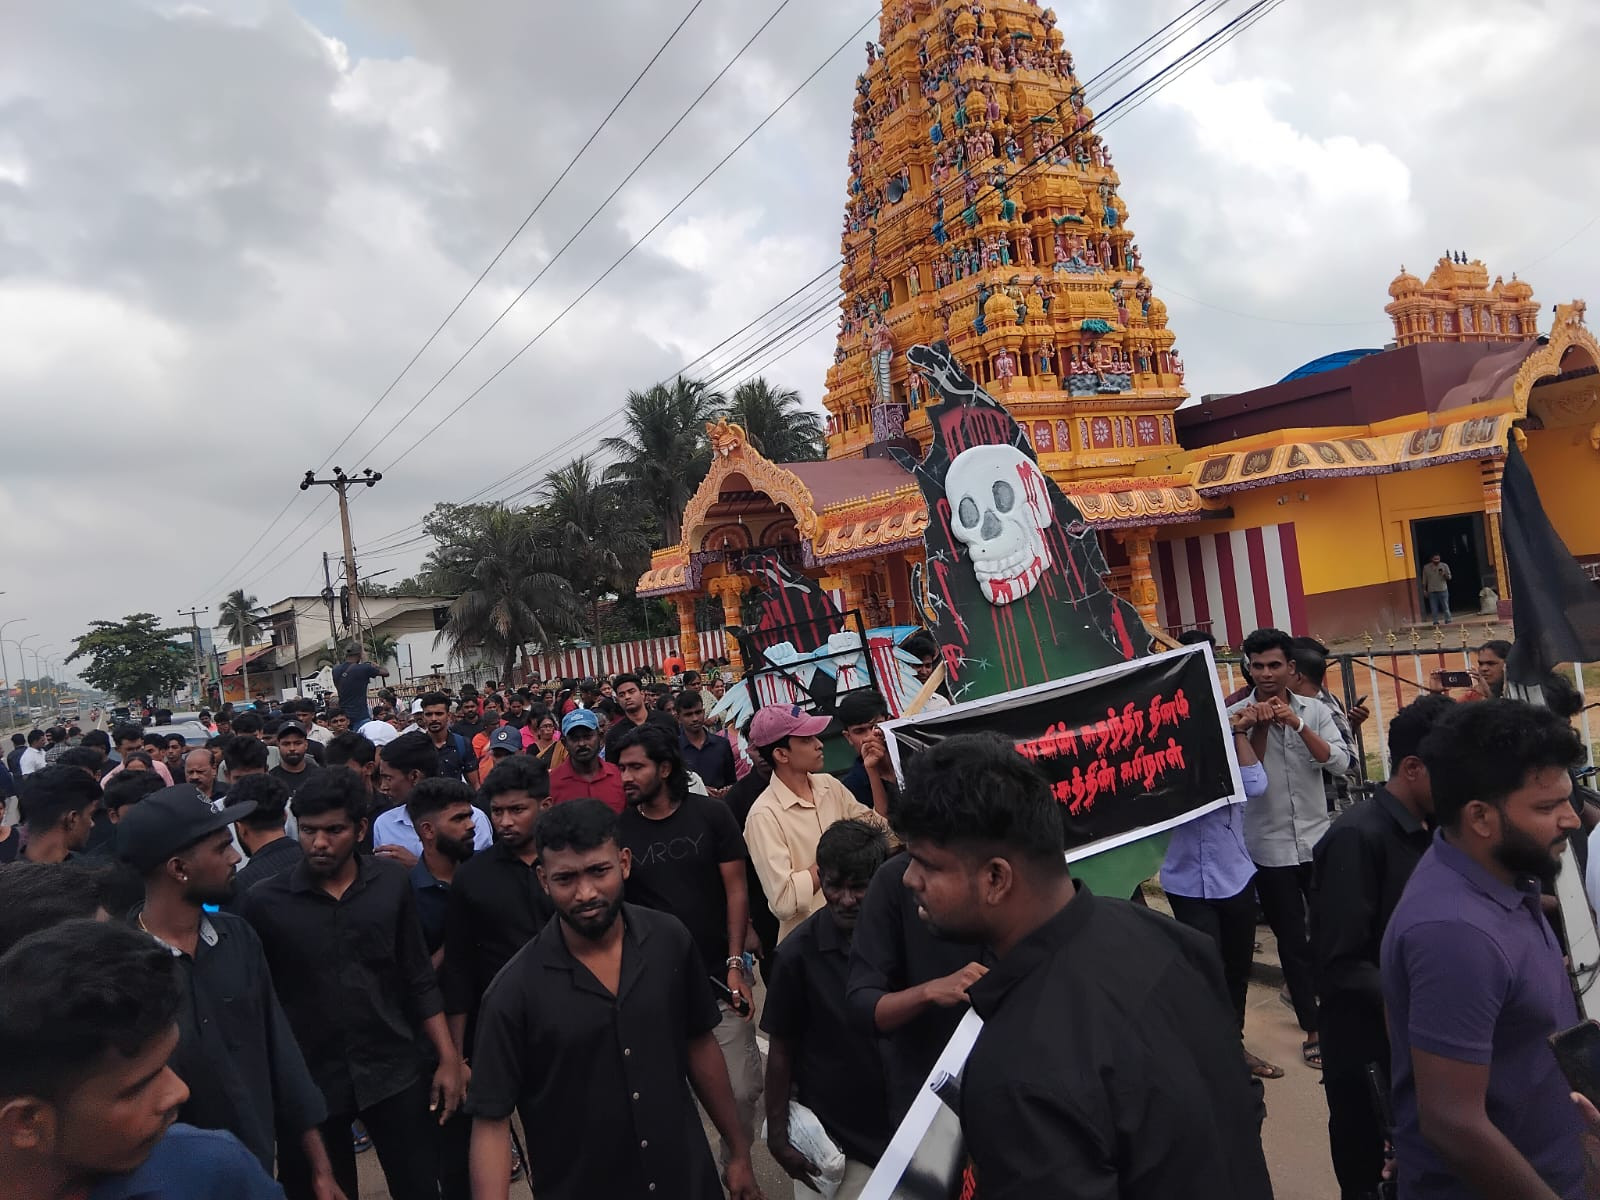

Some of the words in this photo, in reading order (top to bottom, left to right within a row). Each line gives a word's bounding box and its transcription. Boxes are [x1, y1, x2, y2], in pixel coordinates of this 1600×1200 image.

[1080, 702, 1144, 758] சுதந்திர
[1147, 688, 1190, 742] தினம்
[1120, 737, 1186, 791] கரிநாள்
